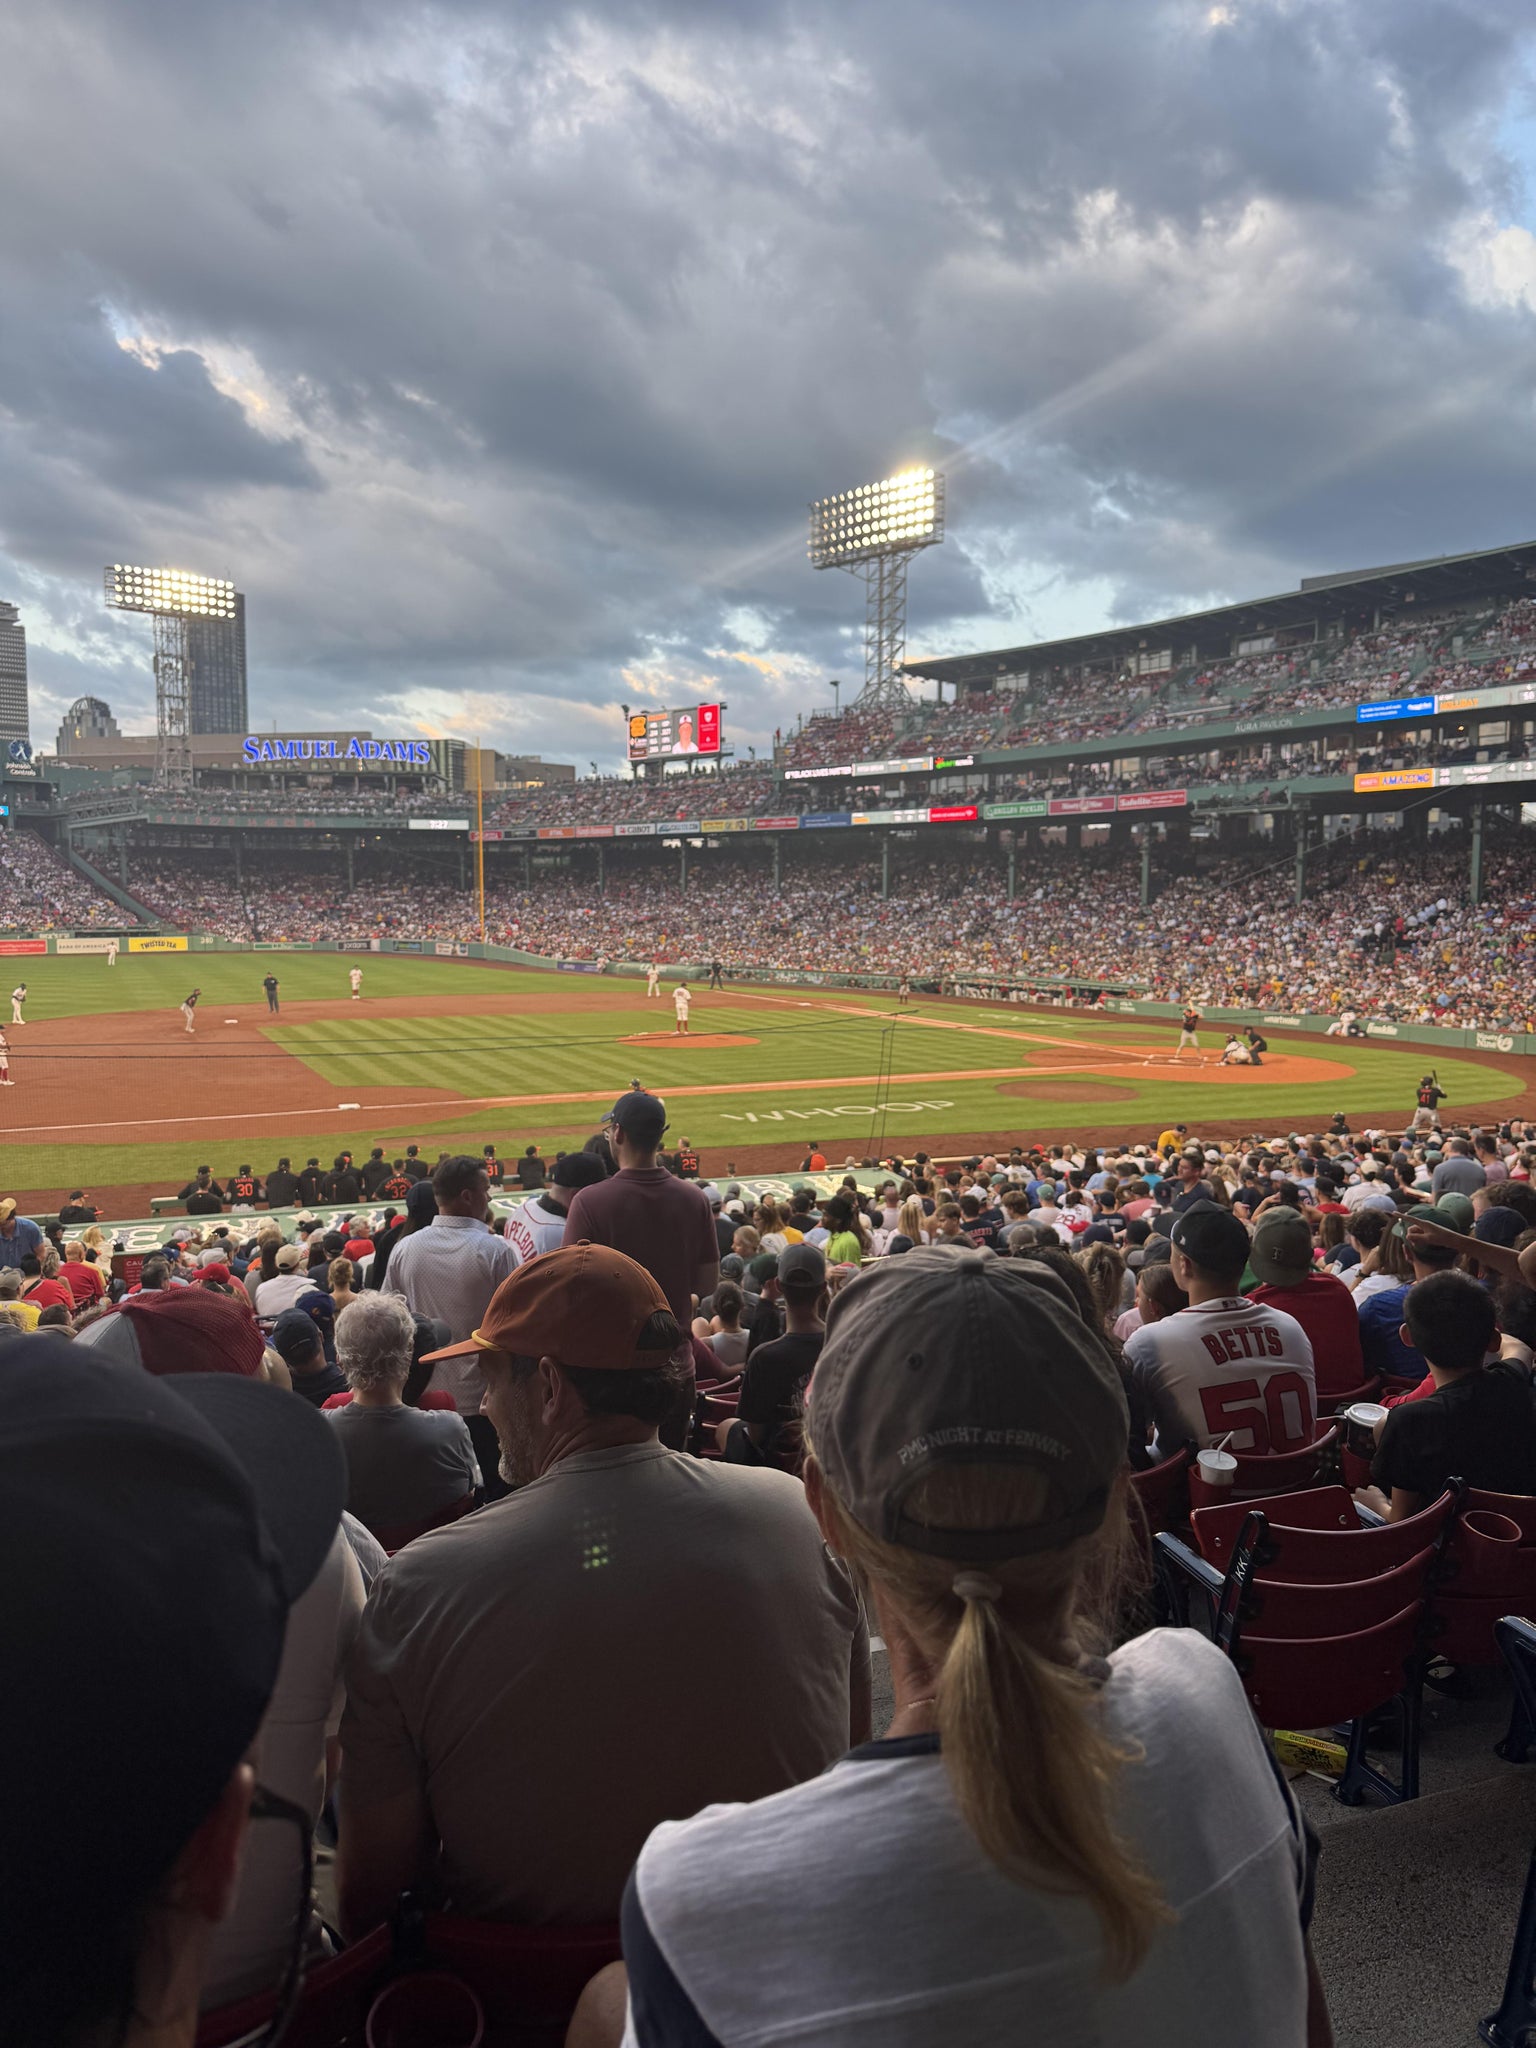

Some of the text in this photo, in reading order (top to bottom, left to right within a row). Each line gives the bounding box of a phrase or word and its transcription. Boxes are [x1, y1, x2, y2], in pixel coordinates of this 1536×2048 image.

[1260, 718, 1293, 729] PAVILION
[242, 736, 431, 764] SAMUEL ADAMS
[6, 762, 32, 770] Johnson
[10, 768, 37, 777] Controls
[627, 825, 650, 833] CABOT
[141, 940, 177, 949] TWISTED TEA
[1366, 1022, 1398, 1036] Franklin
[1476, 1039, 1497, 1049] Nine
[720, 1100, 954, 1123] WHOOP
[487, 1165, 498, 1176] 31
[682, 1158, 697, 1170] 25
[236, 1184, 253, 1197] 30
[391, 1184, 408, 1199] 32
[1055, 1213, 1075, 1226] 28
[1201, 1326, 1284, 1366] BETTS
[1199, 1371, 1313, 1456] 50
[896, 1426, 1072, 1465] PMC NIGHT AT FENWAY
